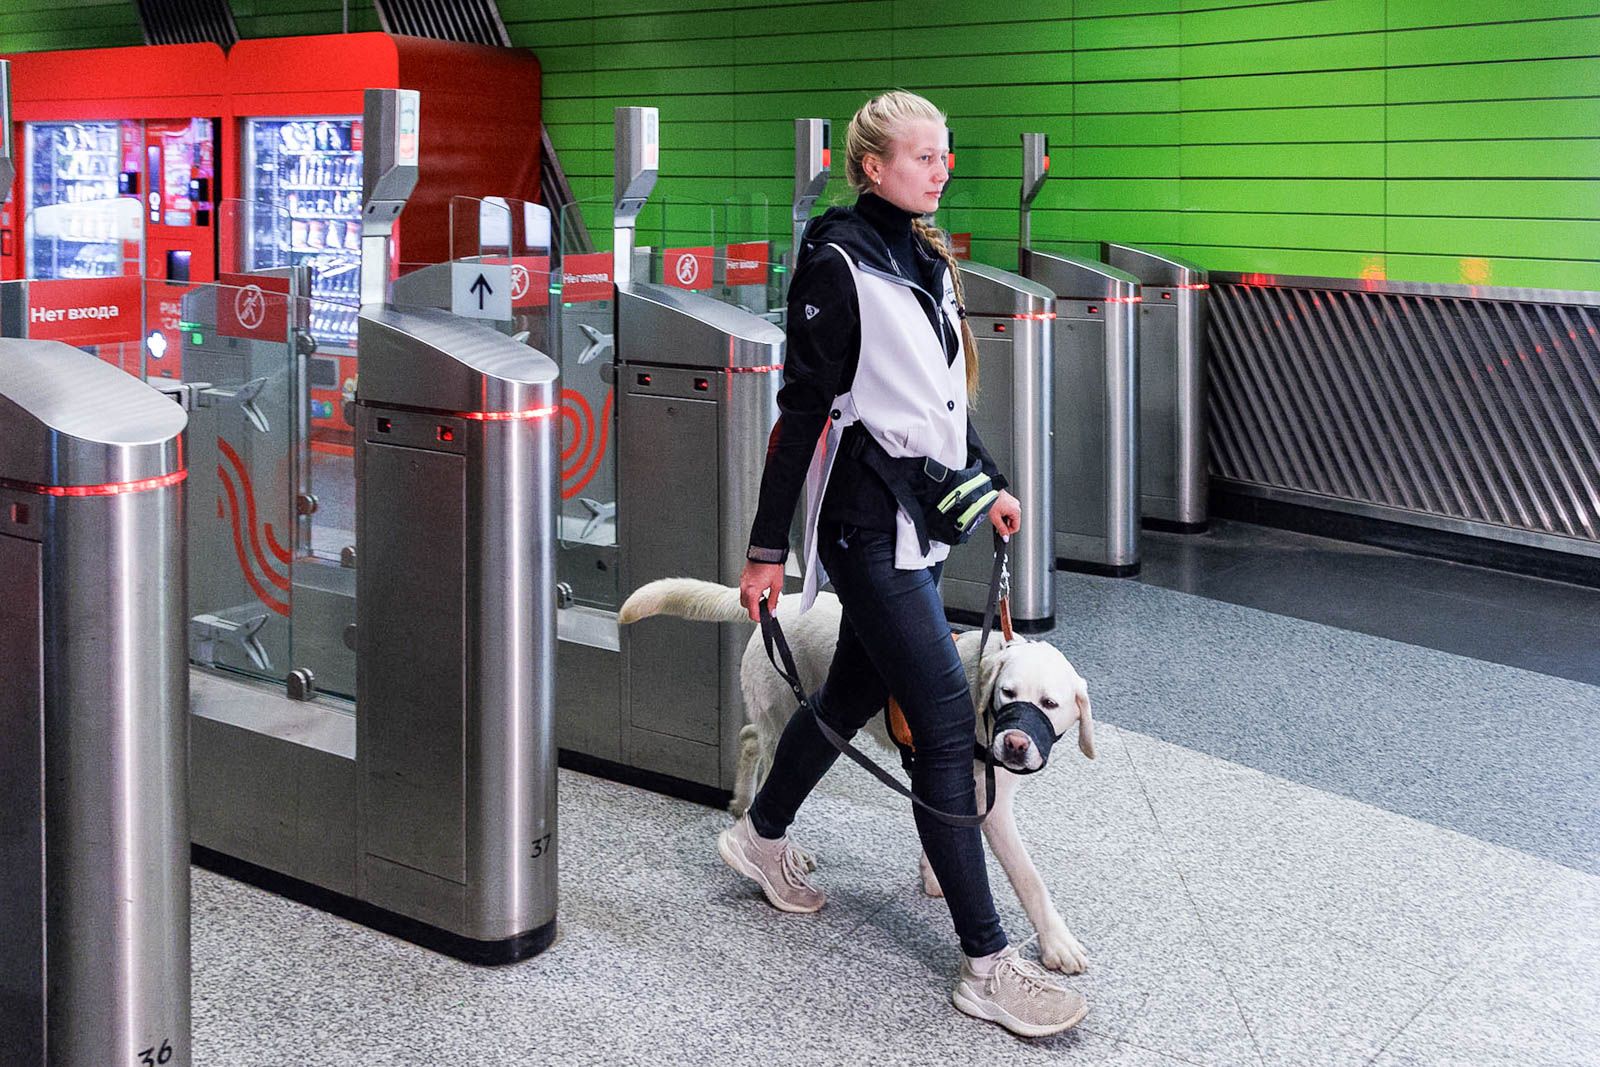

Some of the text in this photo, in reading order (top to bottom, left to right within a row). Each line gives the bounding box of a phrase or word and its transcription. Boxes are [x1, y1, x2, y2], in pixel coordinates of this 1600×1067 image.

[30, 305, 119, 323] Нет входа
[530, 833, 552, 859] 37
[138, 1038, 172, 1067] 36
